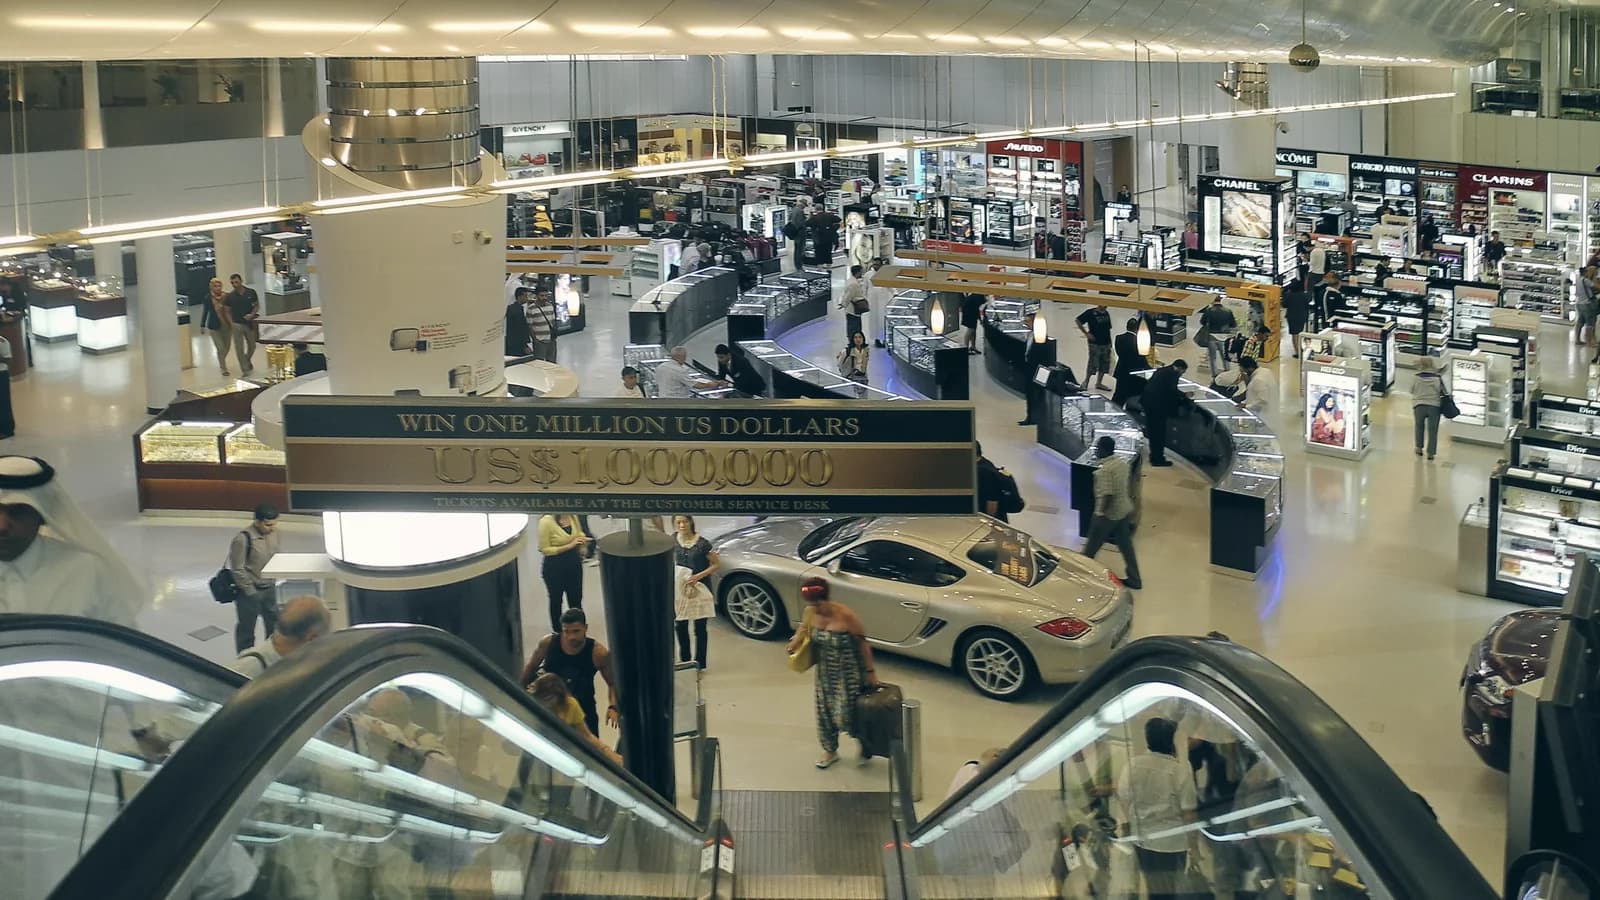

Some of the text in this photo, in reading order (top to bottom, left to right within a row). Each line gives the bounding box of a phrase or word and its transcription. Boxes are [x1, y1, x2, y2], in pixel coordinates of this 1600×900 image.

[512, 124, 546, 133] GIVENCHY
[1351, 162, 1384, 172] GIORGIO
[1384, 164, 1416, 174] ARMANI
[1213, 179, 1261, 191] CHANEL
[1472, 174, 1535, 187] CLARINS
[397, 414, 860, 437] WIN ONE MILLION US DOLLARS
[1566, 443, 1588, 454] Dior
[1550, 485, 1574, 496] Dior
[433, 497, 831, 511] TICKETS AVAILABLE AT THE CUSTOMER SERVICE DESK
